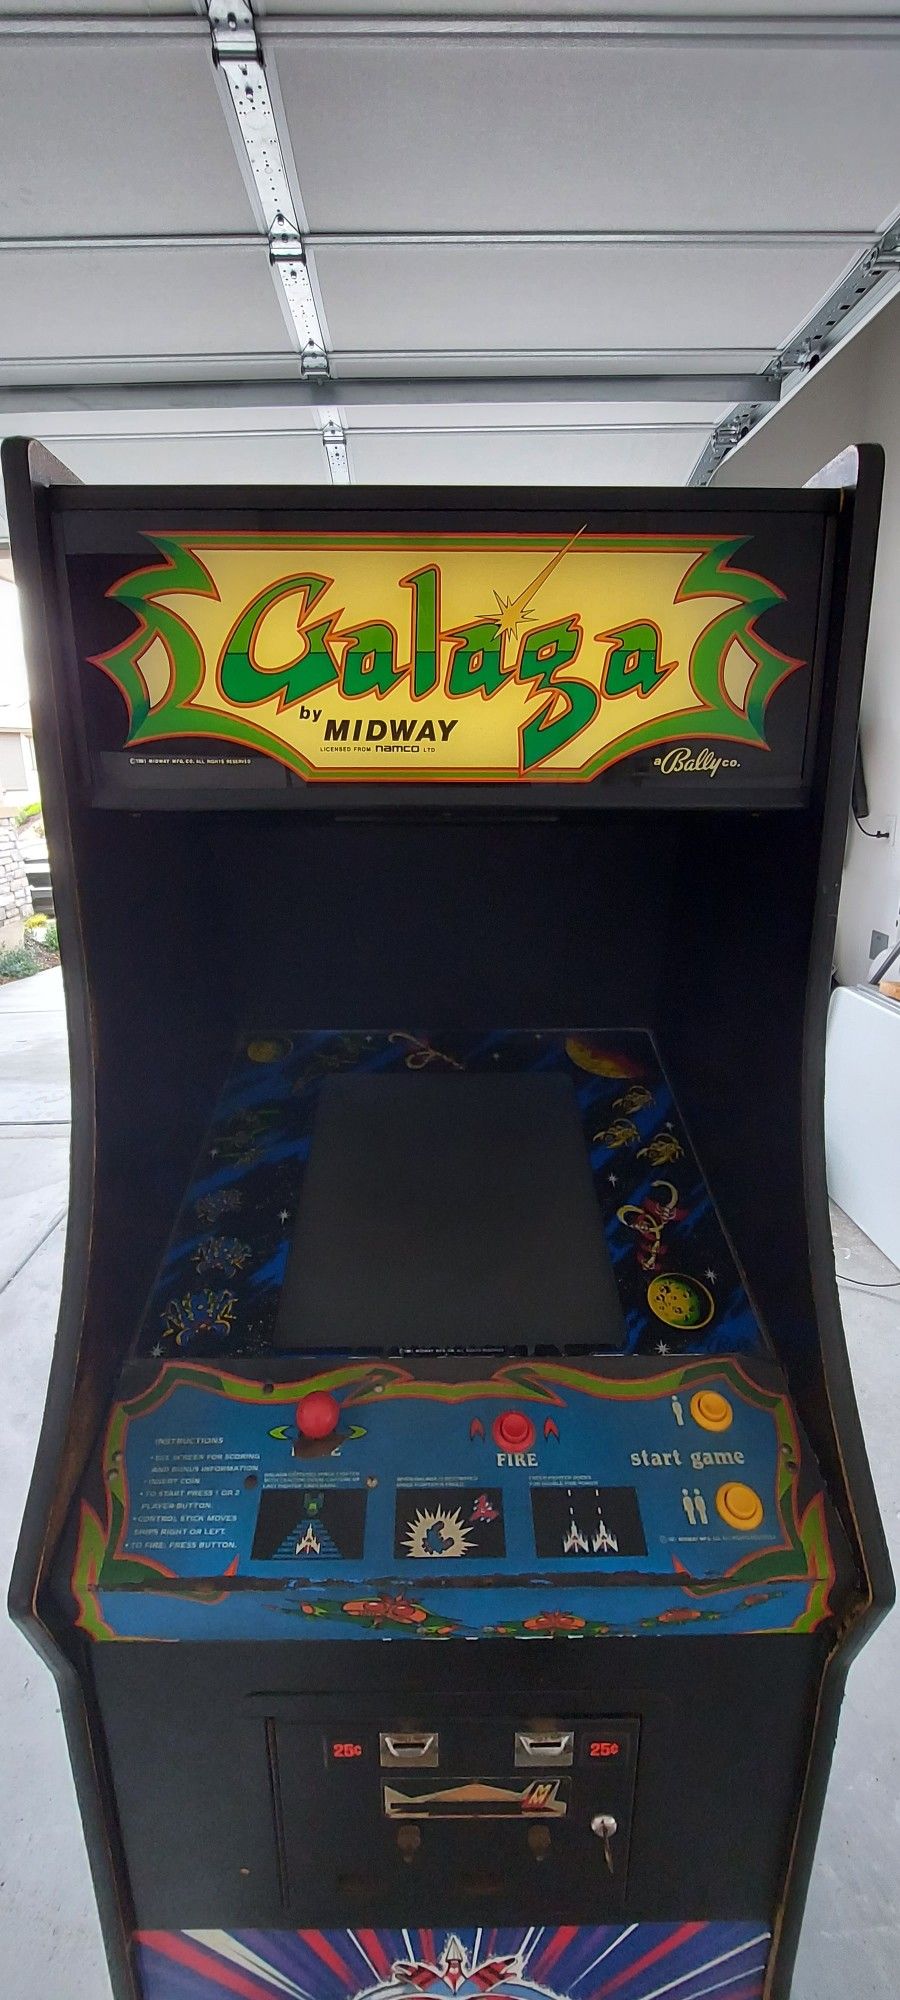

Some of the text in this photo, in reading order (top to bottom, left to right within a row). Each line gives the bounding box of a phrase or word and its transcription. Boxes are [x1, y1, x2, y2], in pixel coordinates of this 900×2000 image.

[215, 563, 679, 776] Galaga
[299, 705, 459, 742] by MIDWAY
[375, 745, 420, 753] namco
[653, 757, 662, 766] a
[661, 747, 722, 778] Bally
[155, 1437, 224, 1445] INSTRUCTIONS
[496, 1453, 539, 1467] FIRE
[630, 1450, 745, 1470] start game
[168, 1541, 197, 1549] PRESS
[333, 1743, 363, 1758] 25¢
[589, 1742, 620, 1757] 25¢
